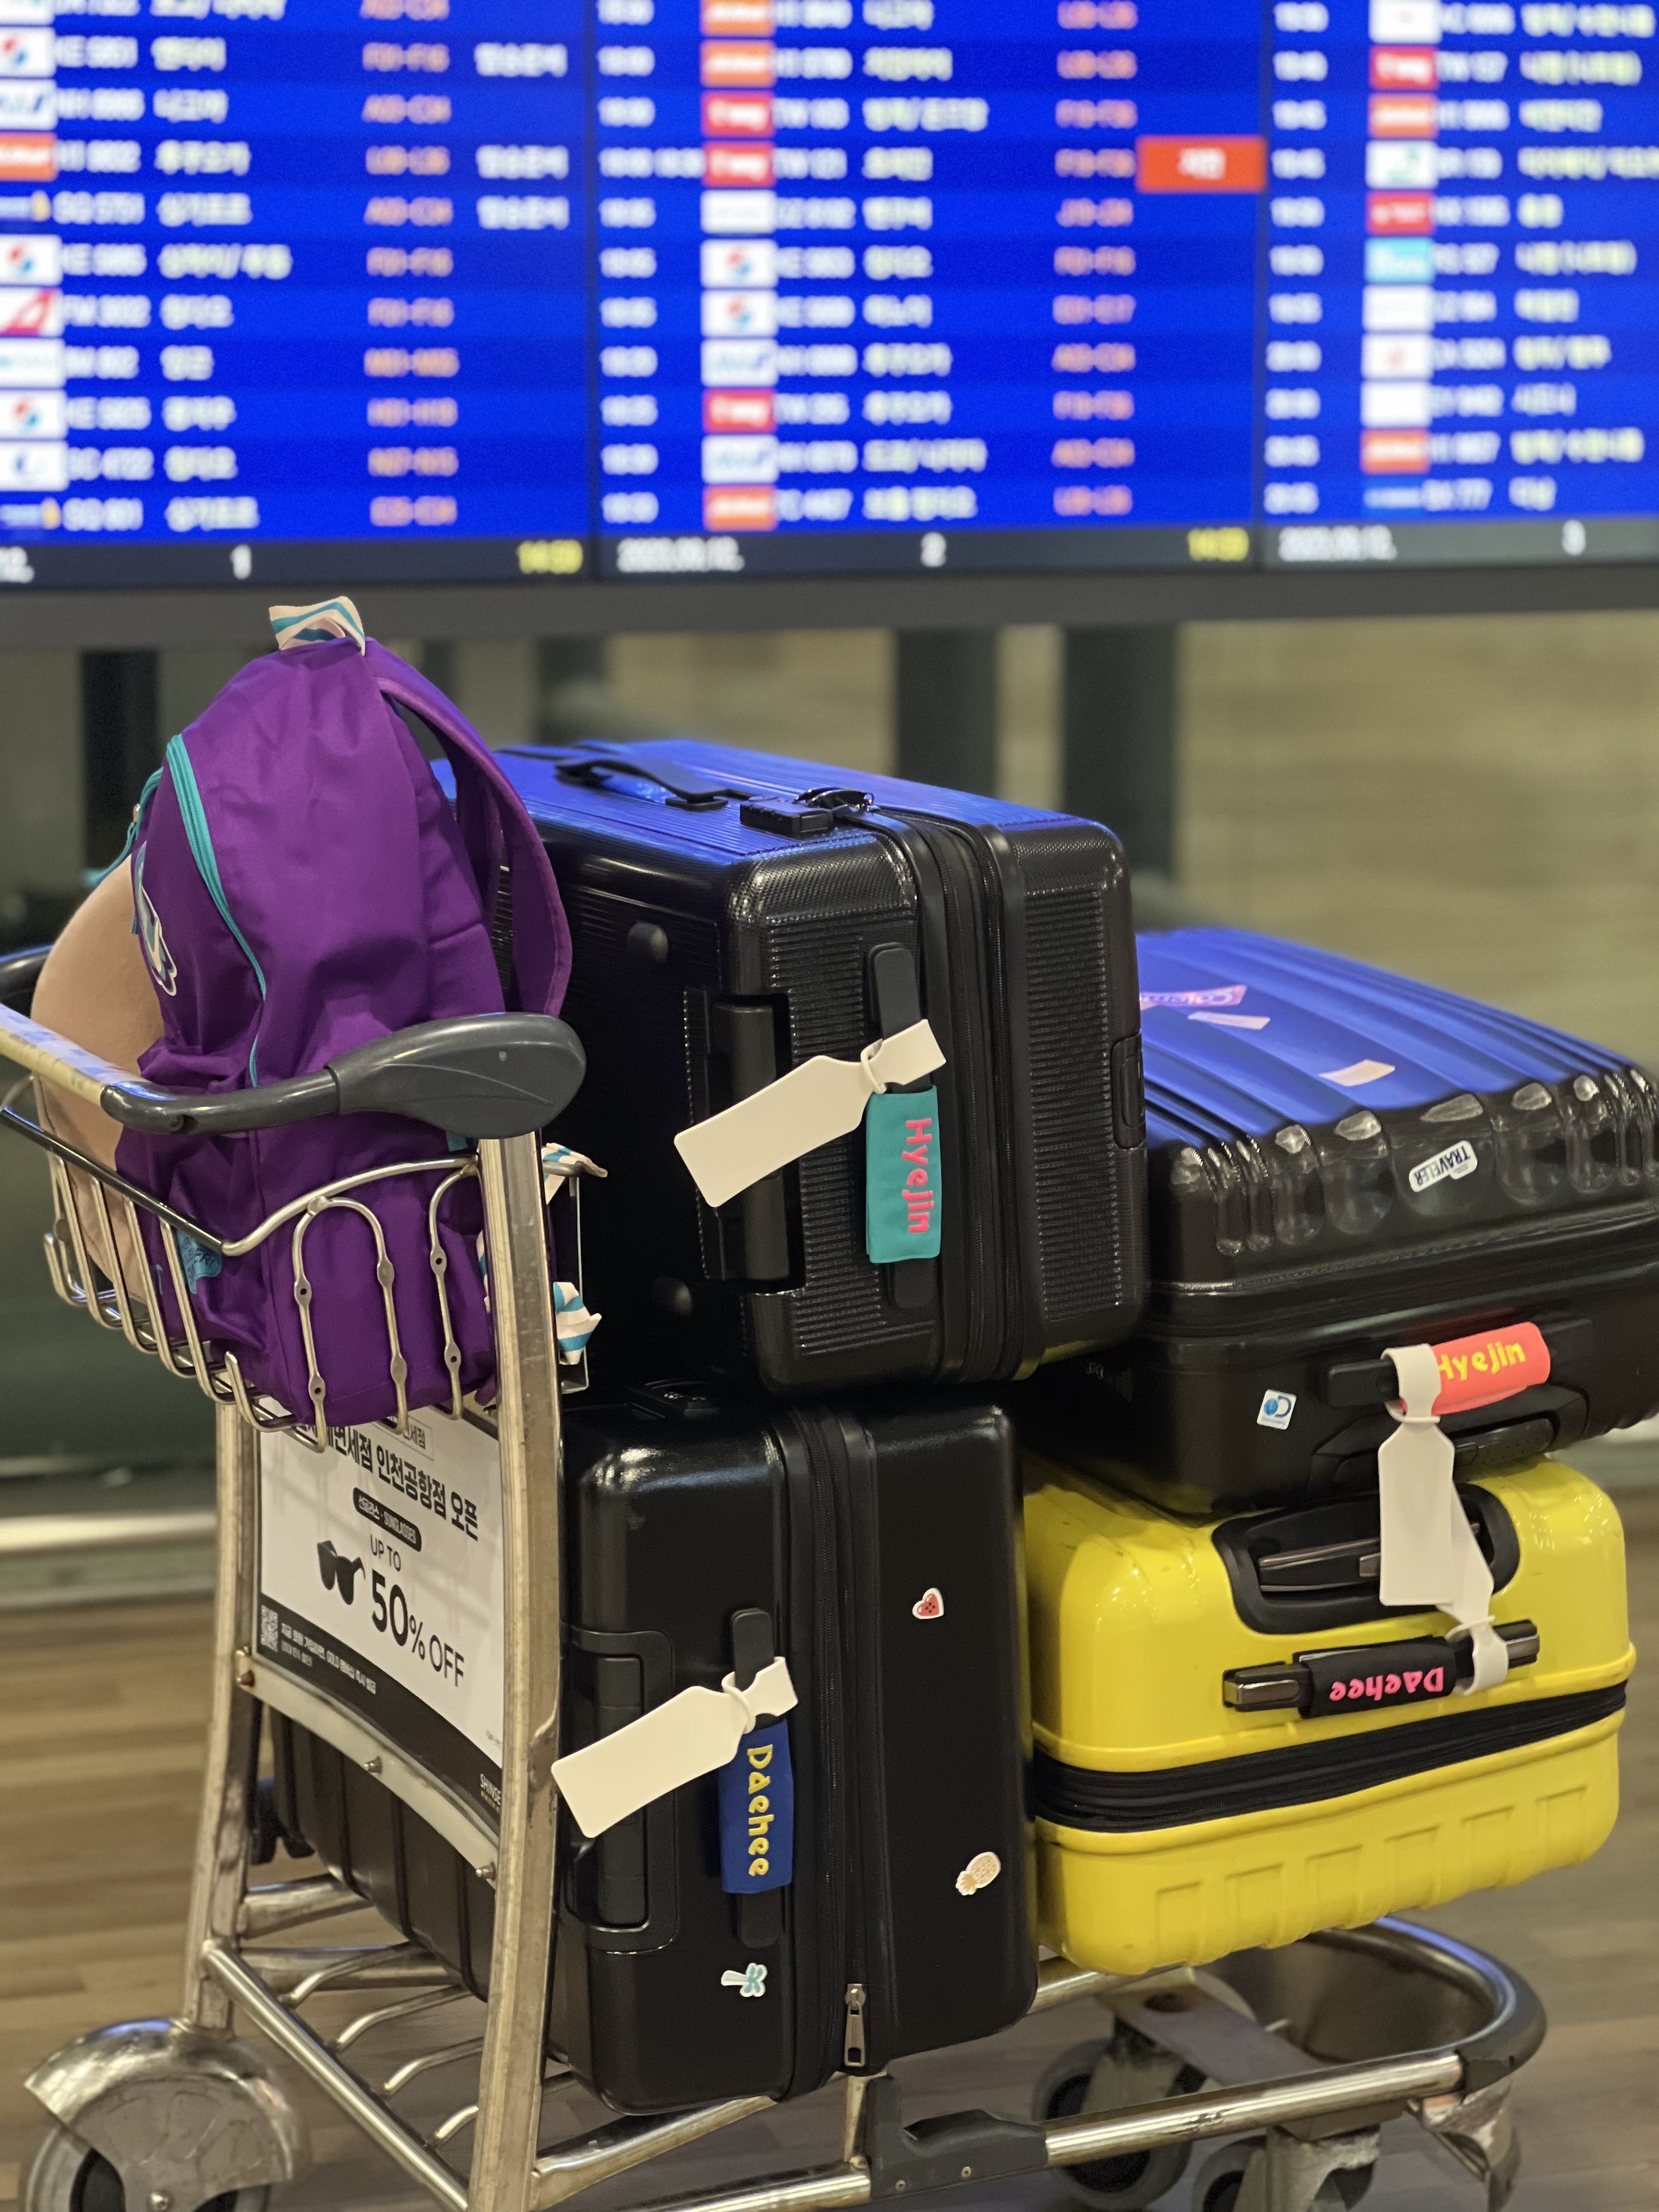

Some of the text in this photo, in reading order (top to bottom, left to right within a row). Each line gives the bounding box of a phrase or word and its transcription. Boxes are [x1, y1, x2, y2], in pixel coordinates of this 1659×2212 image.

[901, 1118, 934, 1233] Hyejin
[1414, 1145, 1471, 1186] TRAVELER
[376, 1444, 446, 1520] 인천공항점
[450, 1491, 478, 1542] 오픈
[370, 1534, 401, 1572] UP TO
[1329, 1666, 1444, 1701] Daehee
[747, 1743, 775, 1877] Daehee
